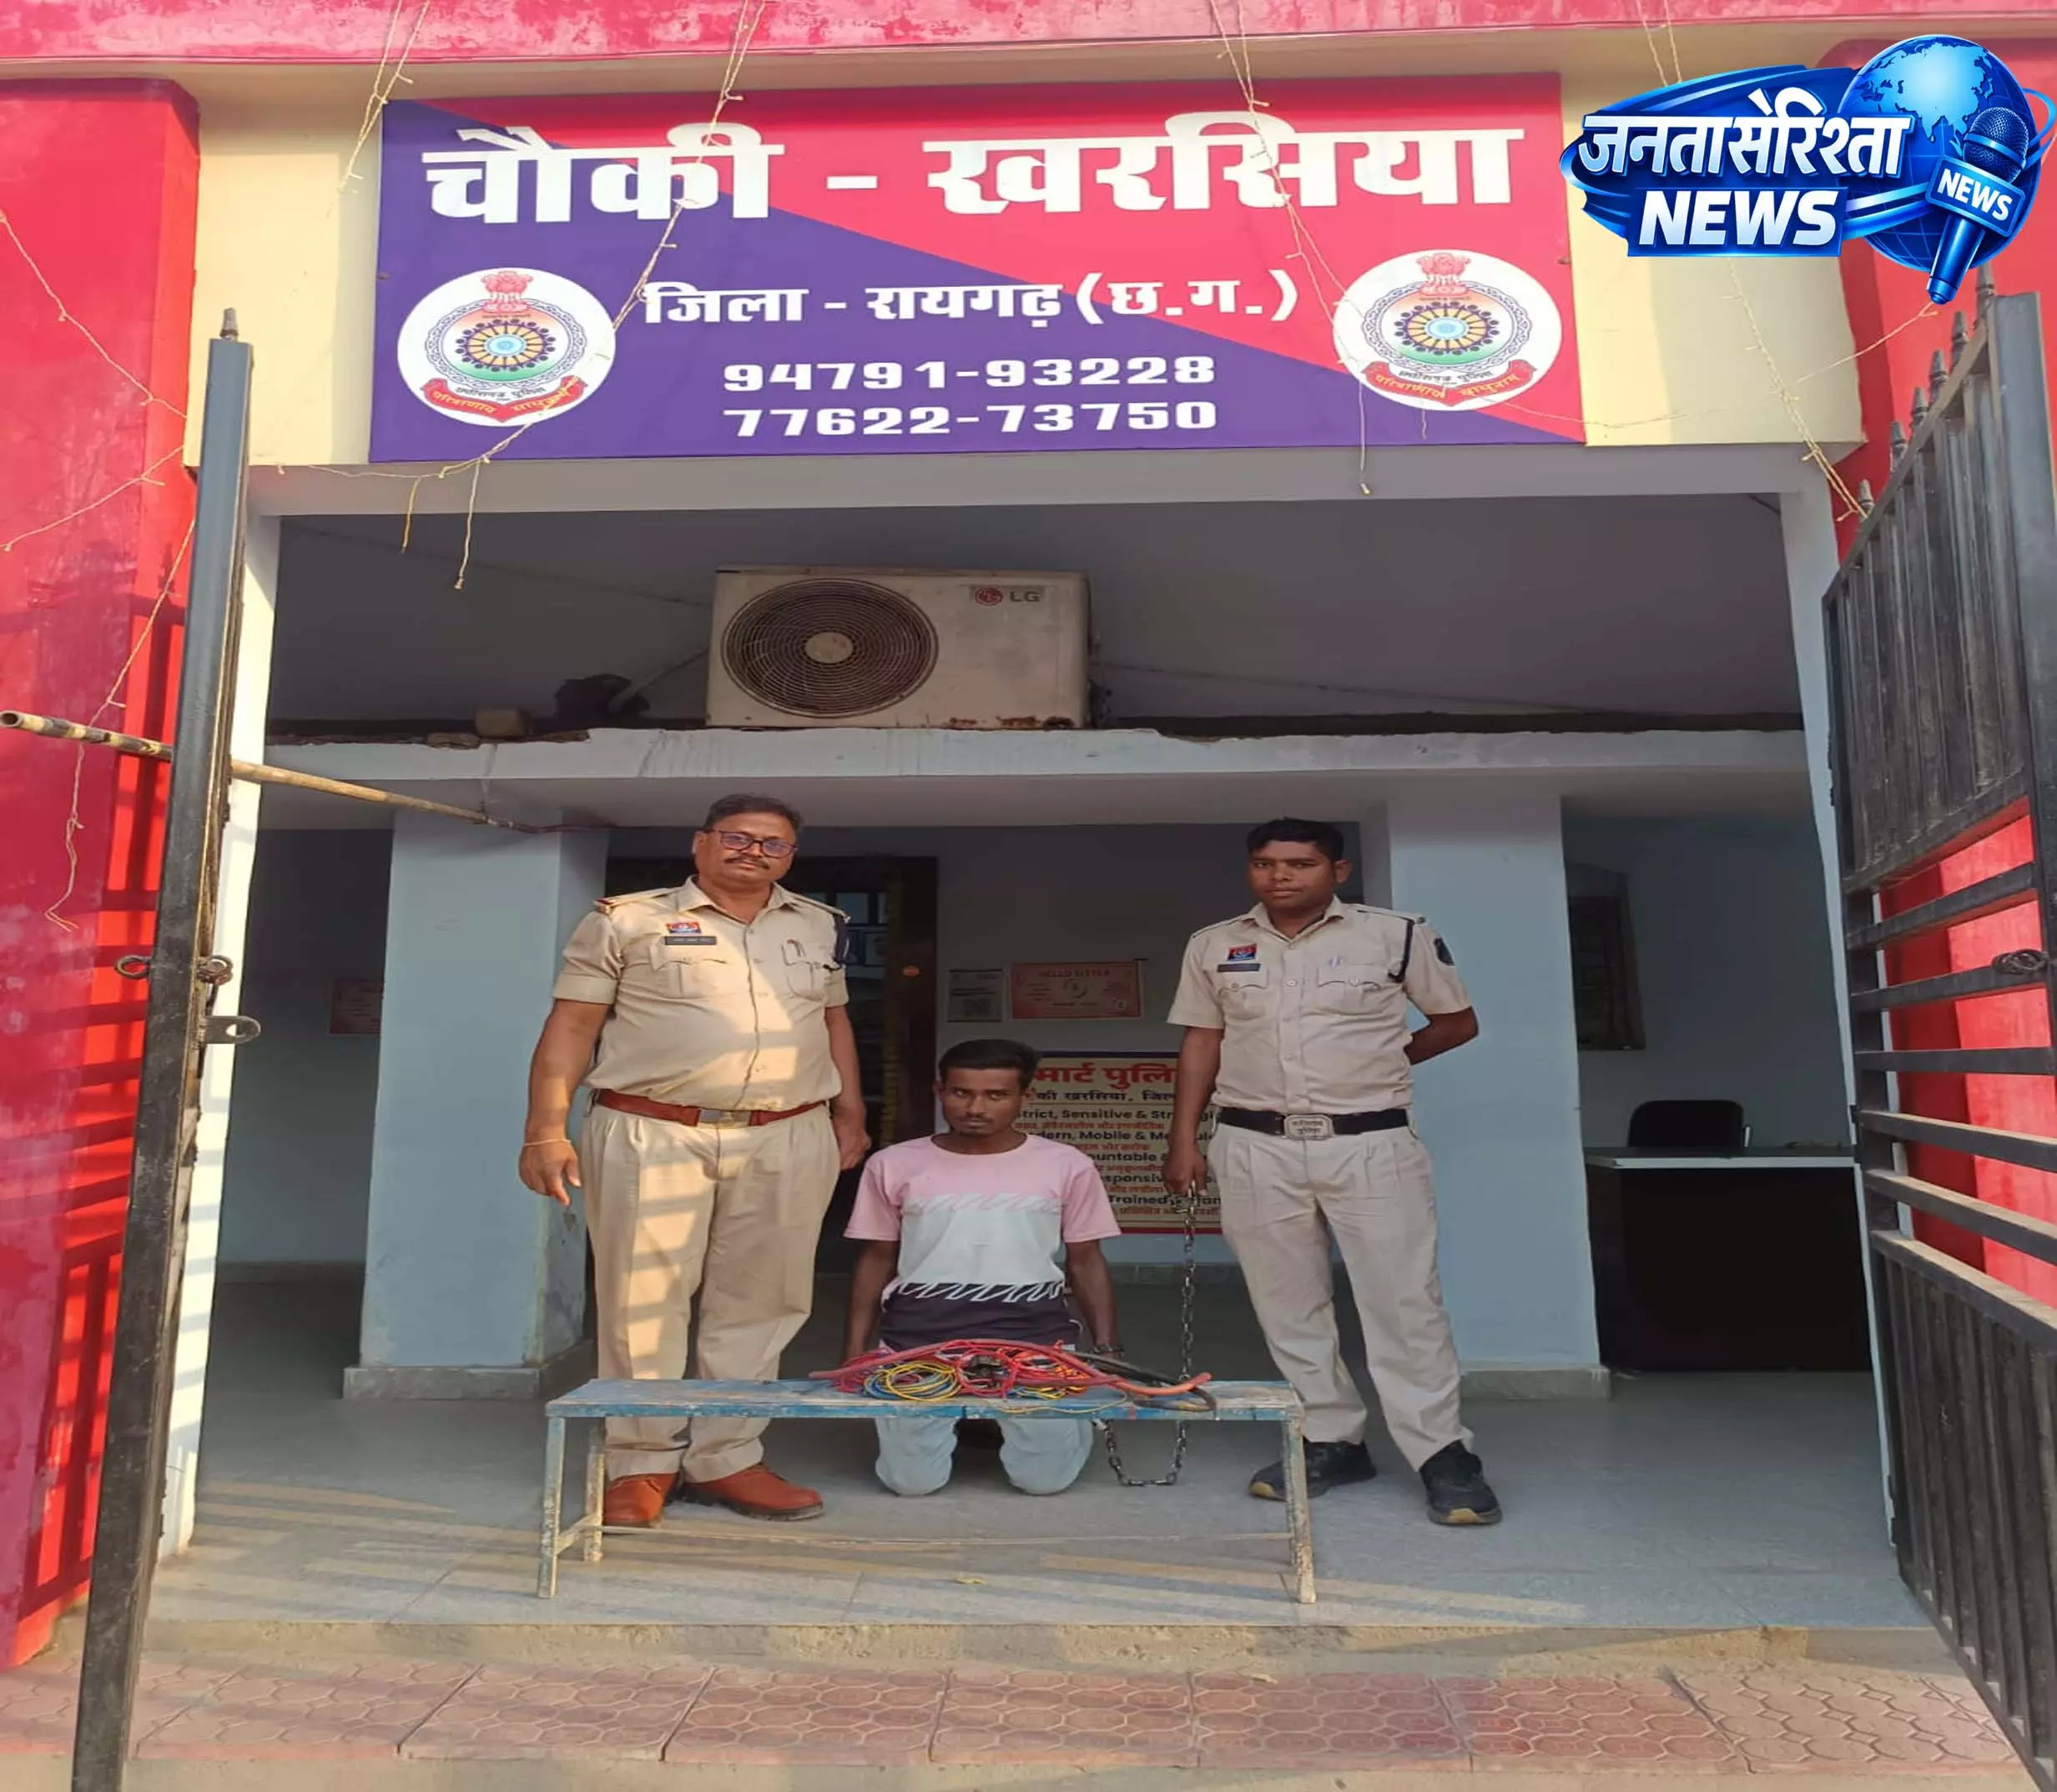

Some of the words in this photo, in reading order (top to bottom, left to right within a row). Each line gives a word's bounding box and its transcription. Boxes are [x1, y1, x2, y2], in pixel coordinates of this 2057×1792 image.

[421, 122, 785, 224] चौकी
[826, 175, 879, 189] -
[922, 110, 1525, 214] खरसिया
[643, 280, 809, 323] जिला
[824, 301, 847, 310] -
[865, 283, 1064, 328] रायगढ़
[723, 355, 1215, 391] 94791-93228
[723, 400, 1217, 438] 77622-73750
[1009, 591, 1041, 602] LG
[1035, 1061, 1096, 1084] मार्ट
[1102, 1062, 1178, 1091] पुलि
[1020, 1110, 1057, 1120] trict,
[1061, 1110, 1132, 1120] Sensitive
[1135, 1110, 1147, 1119] &
[1079, 1130, 1132, 1140] Mobile
[1135, 1131, 1147, 1140] &
